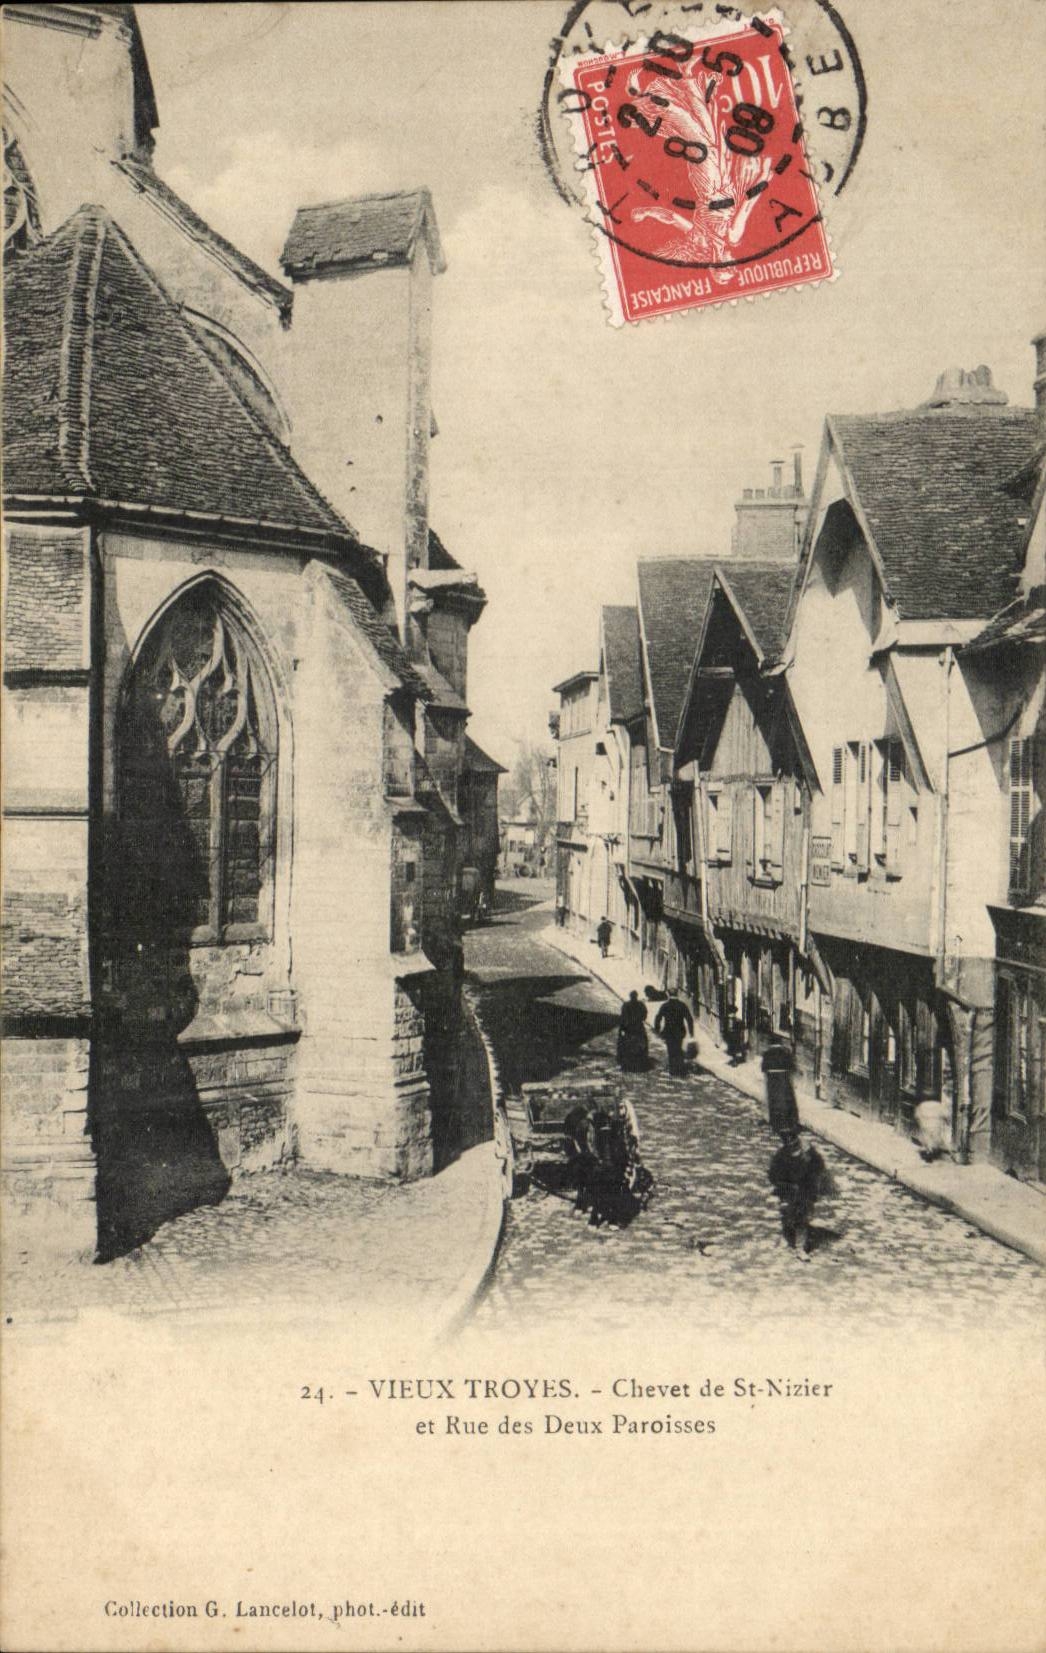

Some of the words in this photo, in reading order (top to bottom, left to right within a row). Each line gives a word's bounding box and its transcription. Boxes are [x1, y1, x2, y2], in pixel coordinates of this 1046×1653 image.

[587, 80, 617, 165] POSTES
[737, 252, 823, 287] REPUBLIQUE
[630, 277, 713, 311] FRANÇAISE
